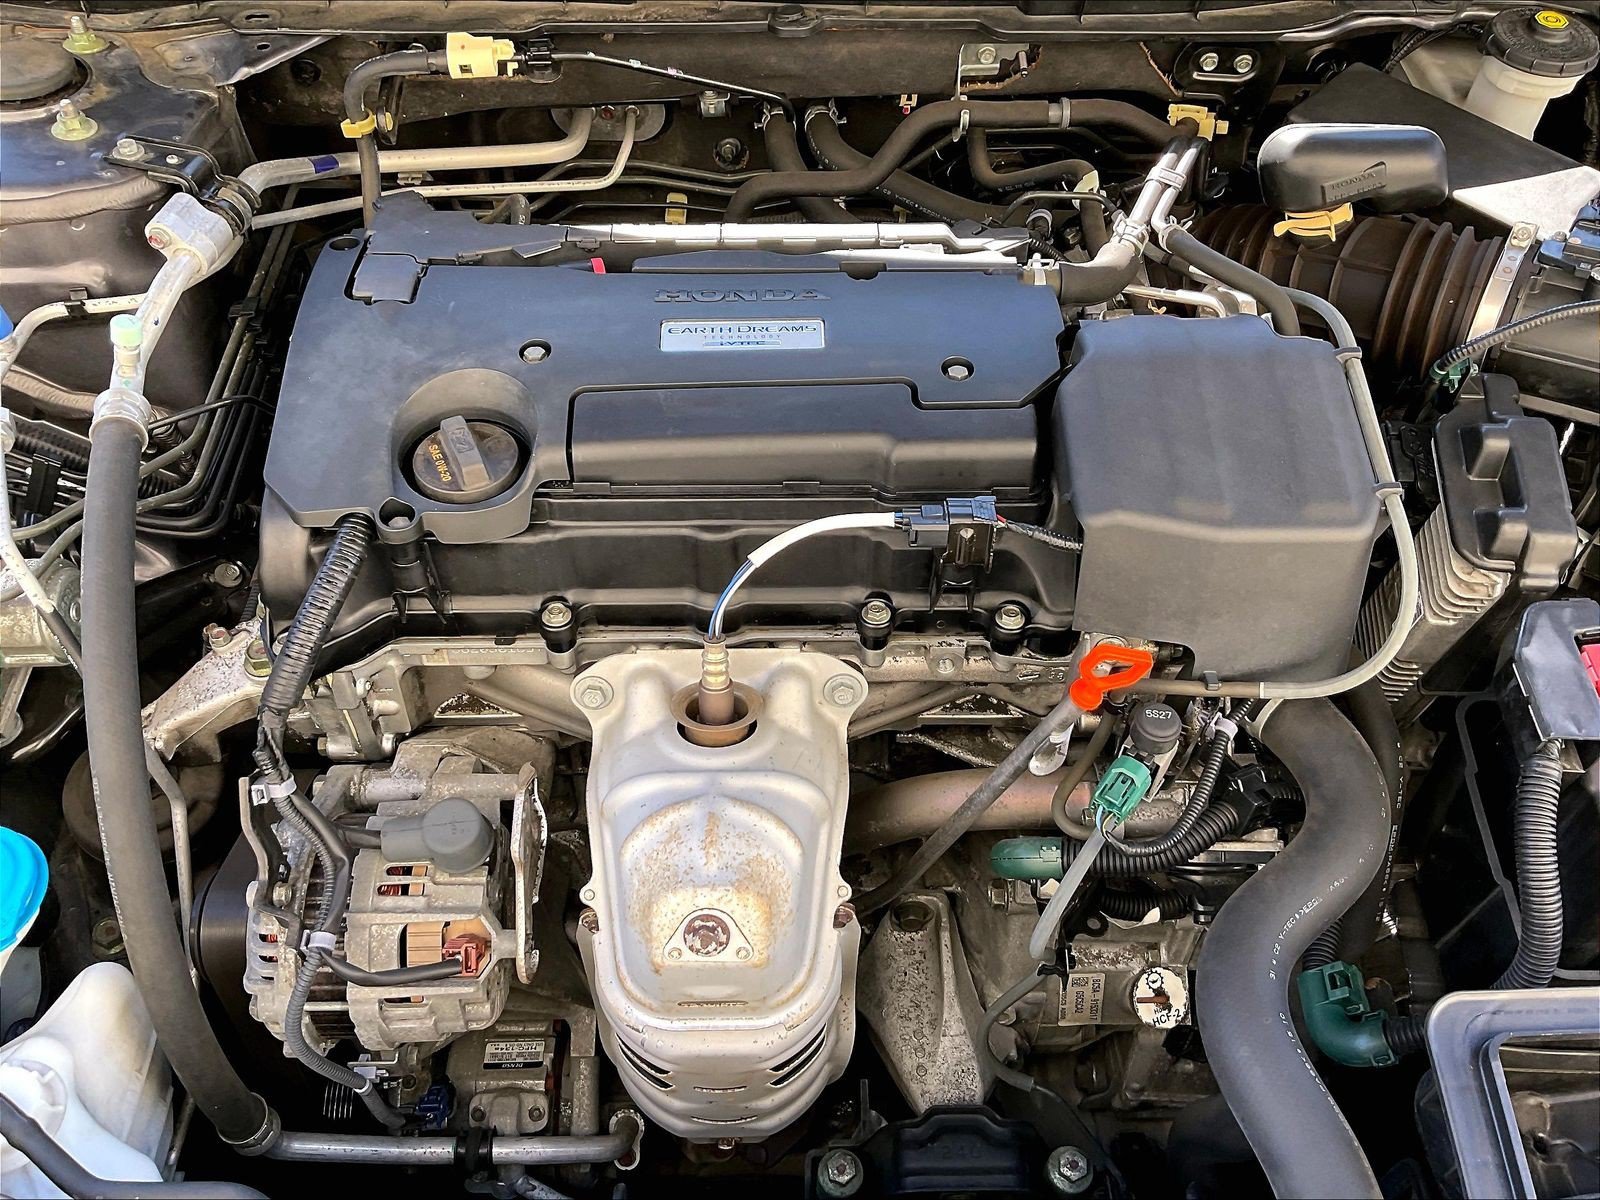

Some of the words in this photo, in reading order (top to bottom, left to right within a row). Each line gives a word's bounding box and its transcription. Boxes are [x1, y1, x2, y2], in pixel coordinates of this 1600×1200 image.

[654, 289, 831, 302] HONDA
[737, 325, 818, 333] DREAMS
[428, 444, 443, 461] SAE
[435, 459, 452, 482] 0W-20
[1145, 709, 1172, 719] 5S27
[1152, 1008, 1182, 1027] HCF-2
